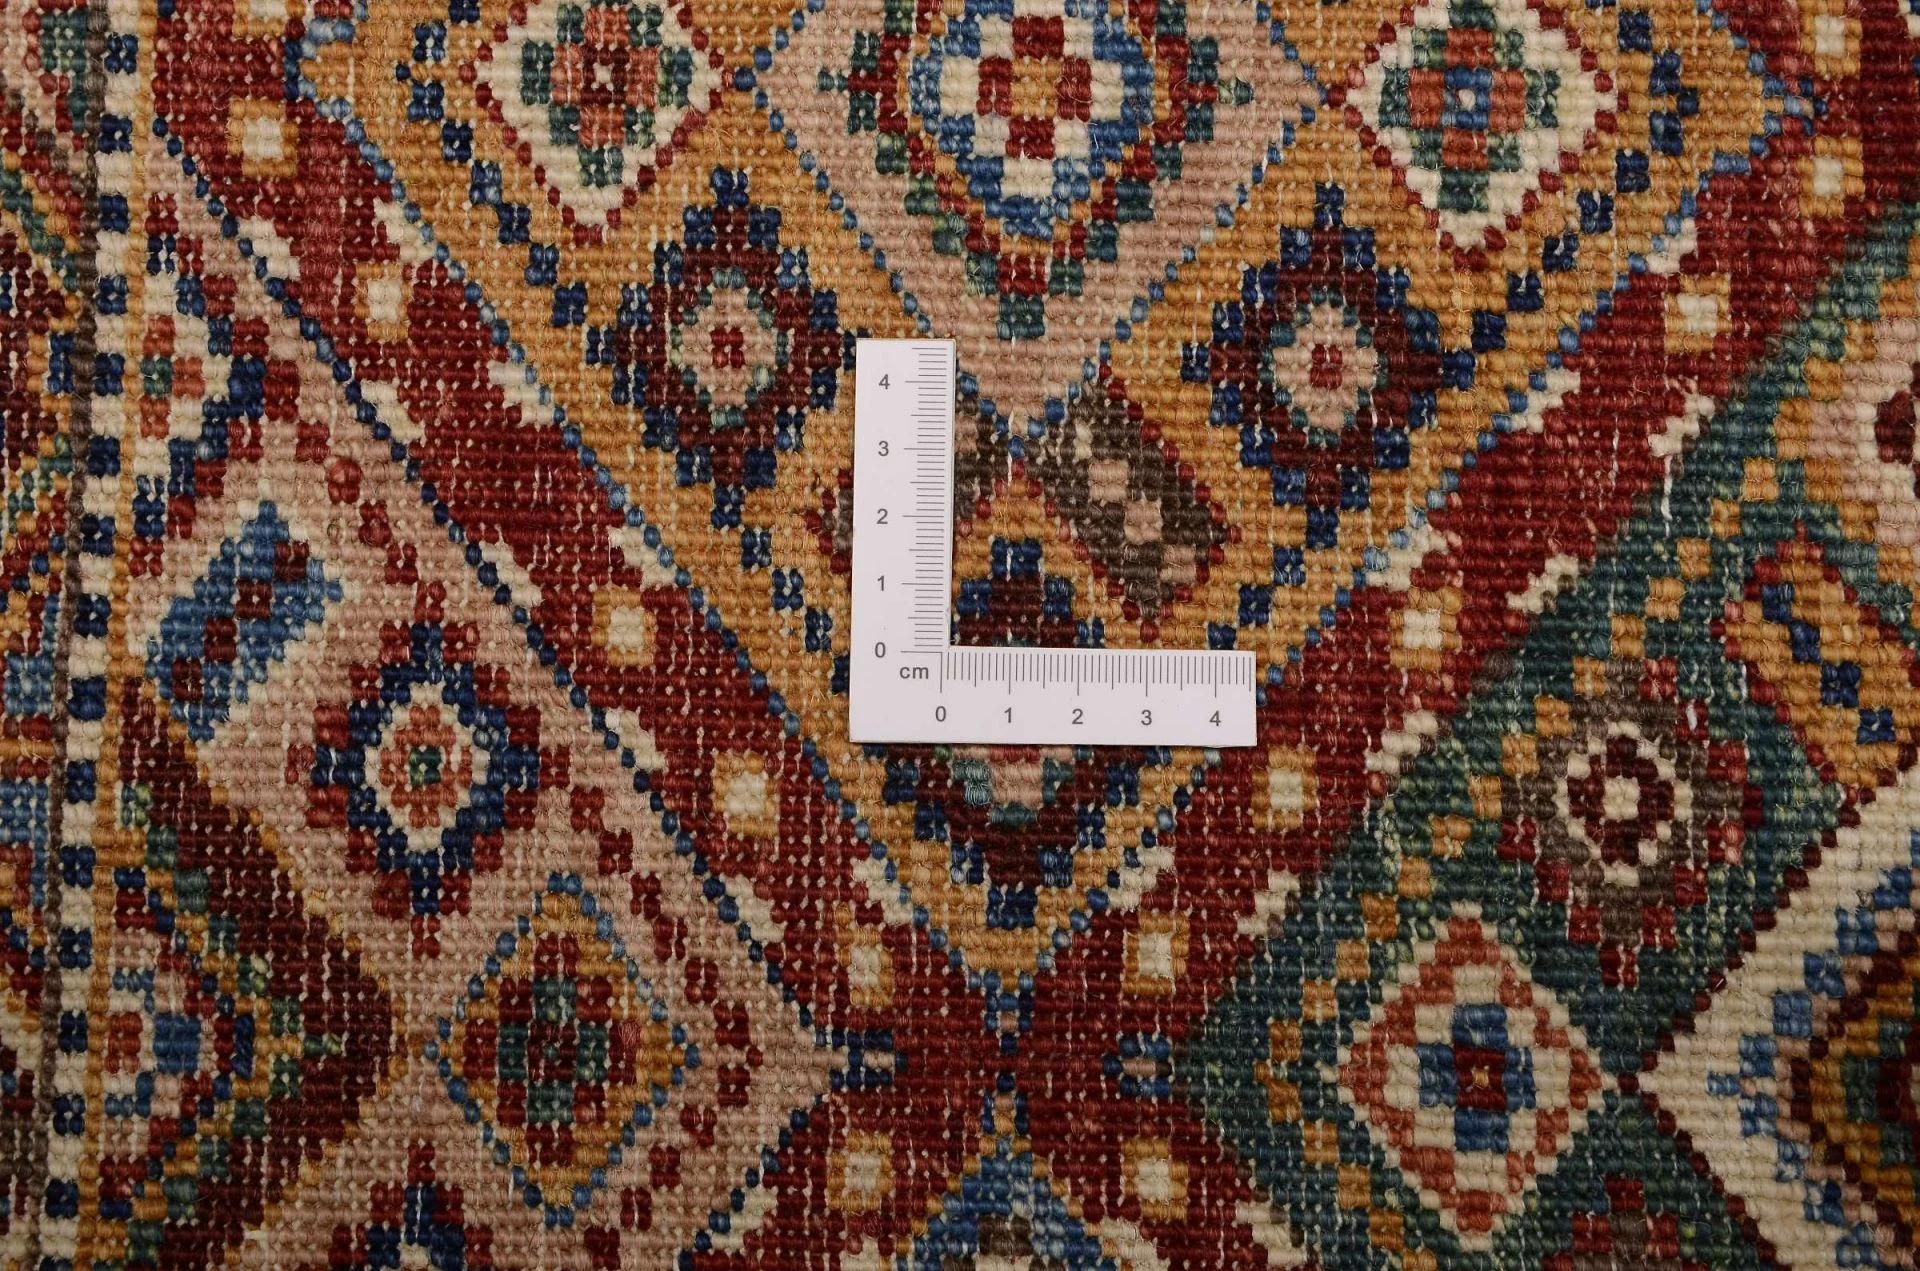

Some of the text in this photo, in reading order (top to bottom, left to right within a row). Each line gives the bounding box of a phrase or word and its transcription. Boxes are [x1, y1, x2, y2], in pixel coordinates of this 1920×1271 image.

[878, 374, 891, 390] 4
[877, 440, 889, 457] 3
[876, 508, 888, 525] 2
[876, 575, 886, 592] 1
[874, 641, 886, 659] 0
[898, 666, 930, 680] cm
[935, 705, 1222, 727] 0 1 2 3 4
